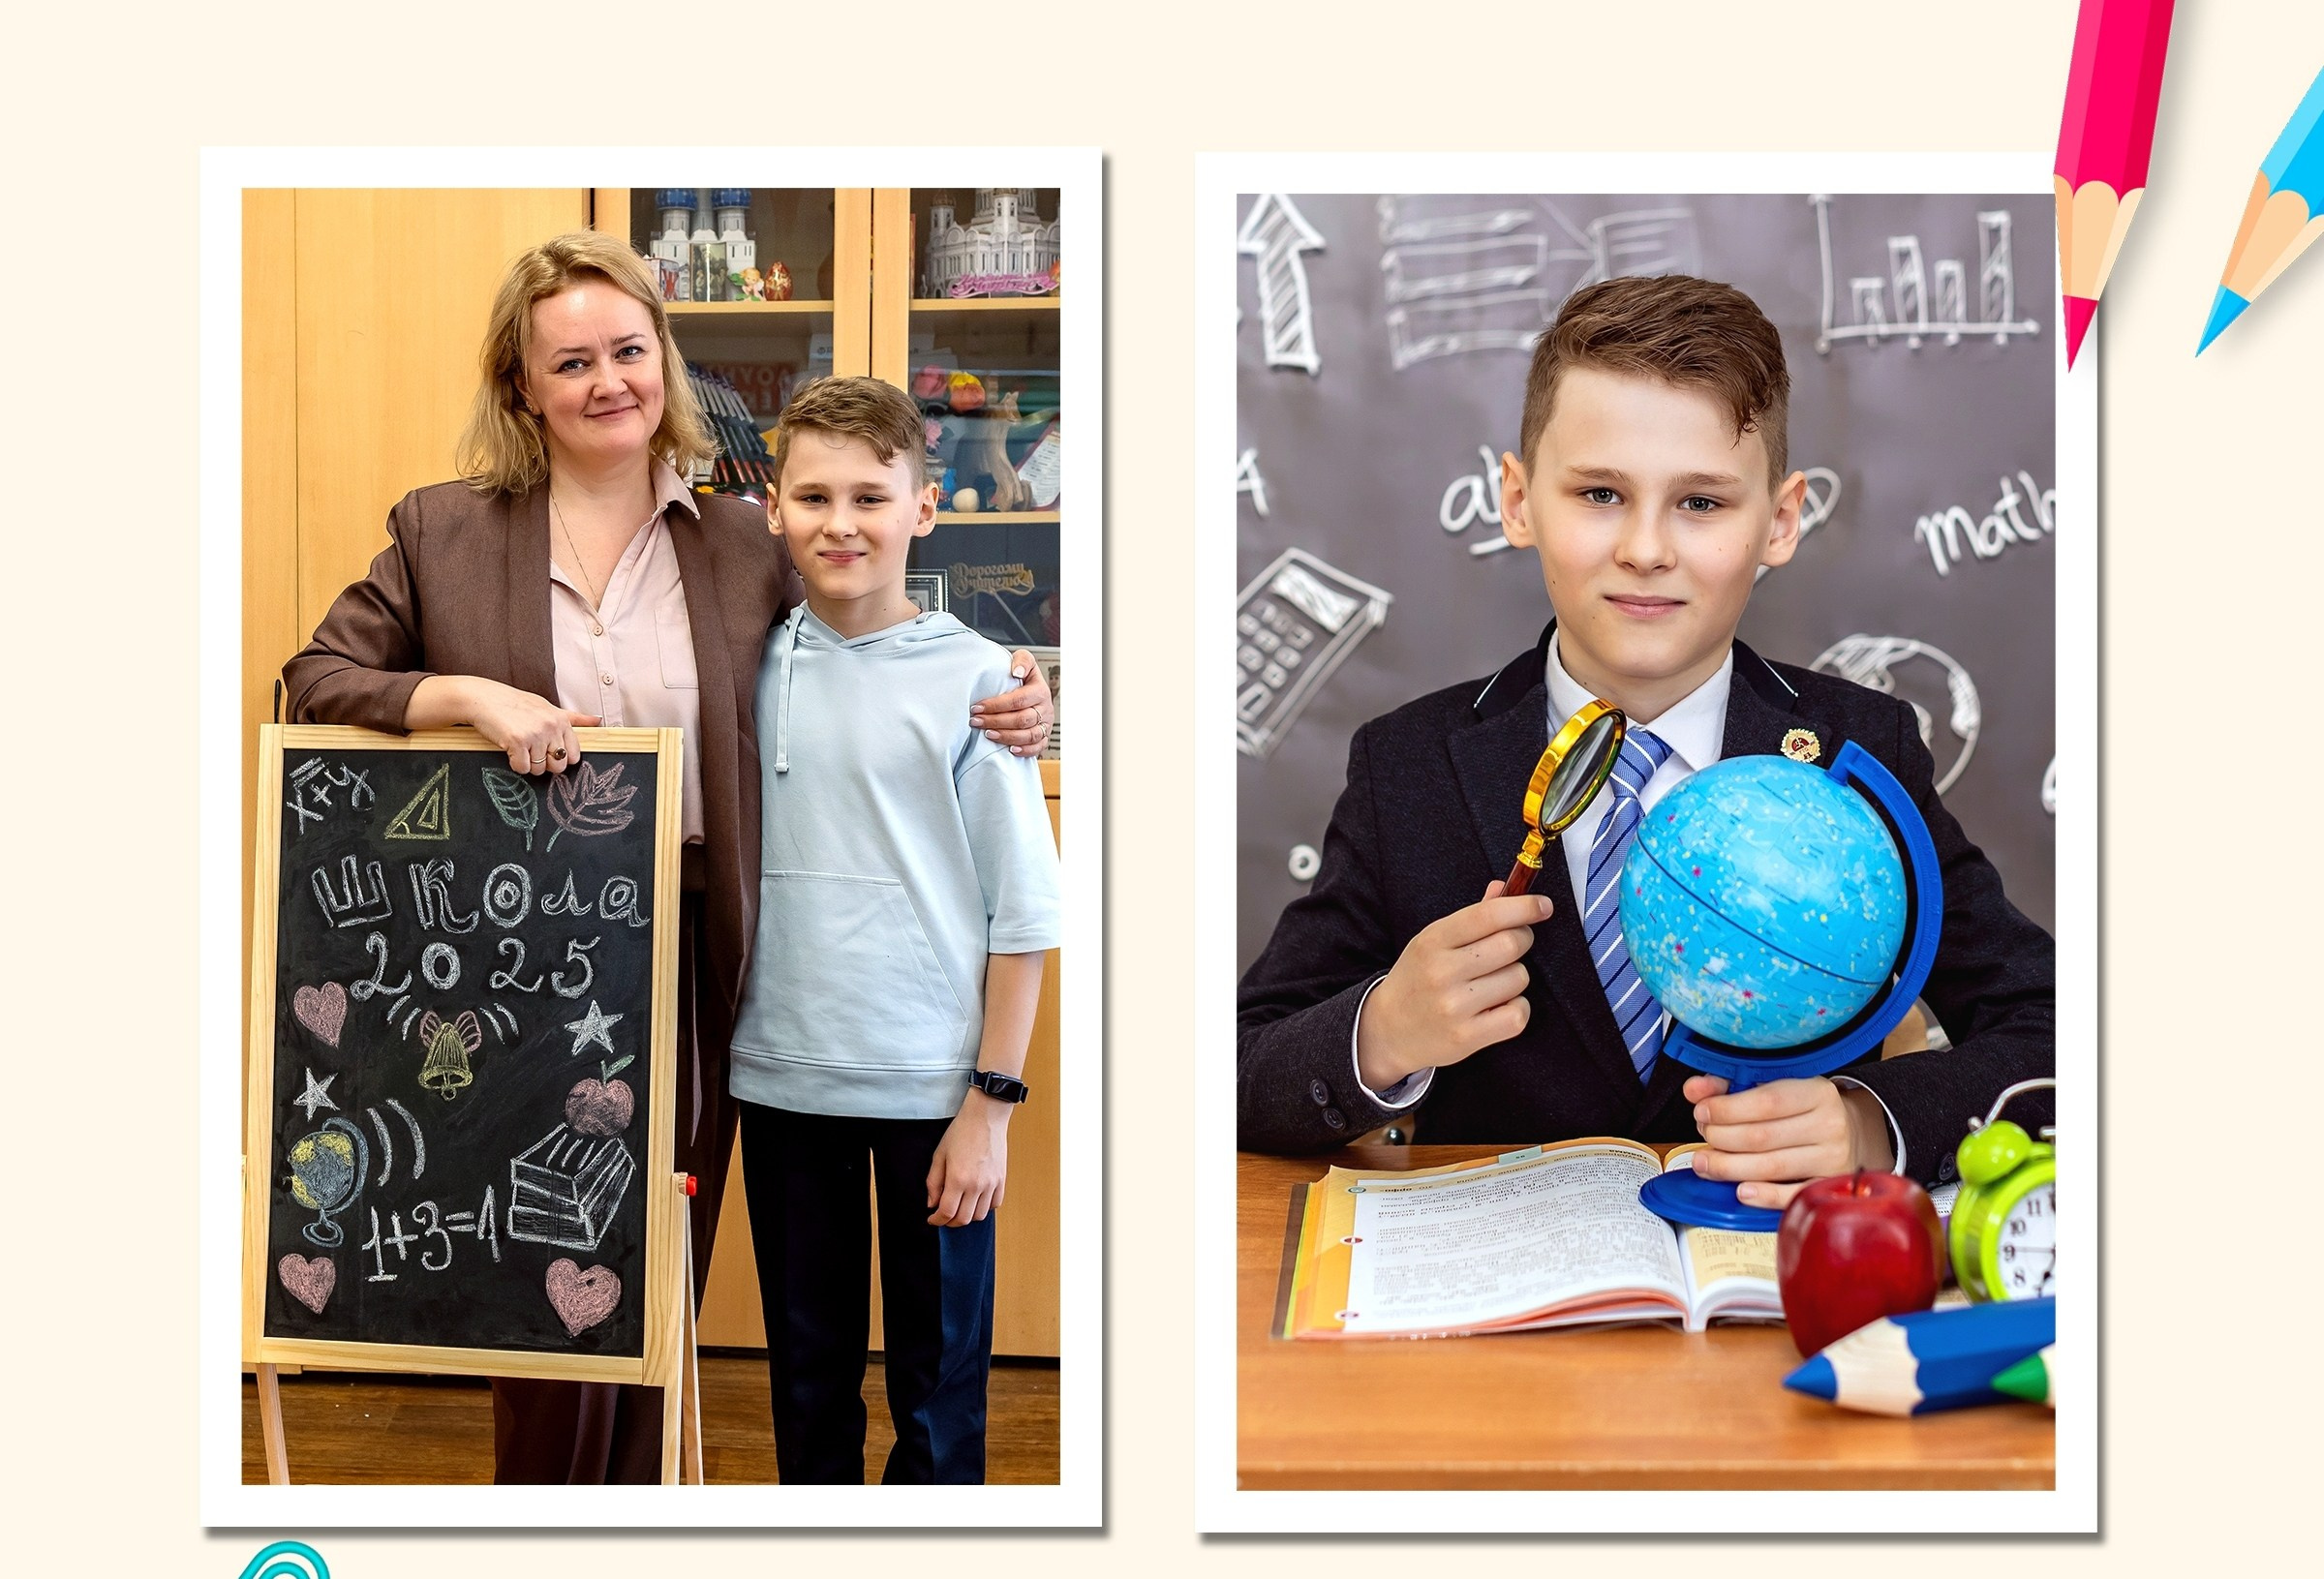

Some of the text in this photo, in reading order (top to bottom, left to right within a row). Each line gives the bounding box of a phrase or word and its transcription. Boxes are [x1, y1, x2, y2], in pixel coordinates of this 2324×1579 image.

[2010, 1217, 2026, 1236] 10
[2003, 1243, 2016, 1263] 9
[2013, 1267, 2026, 1288] 8
